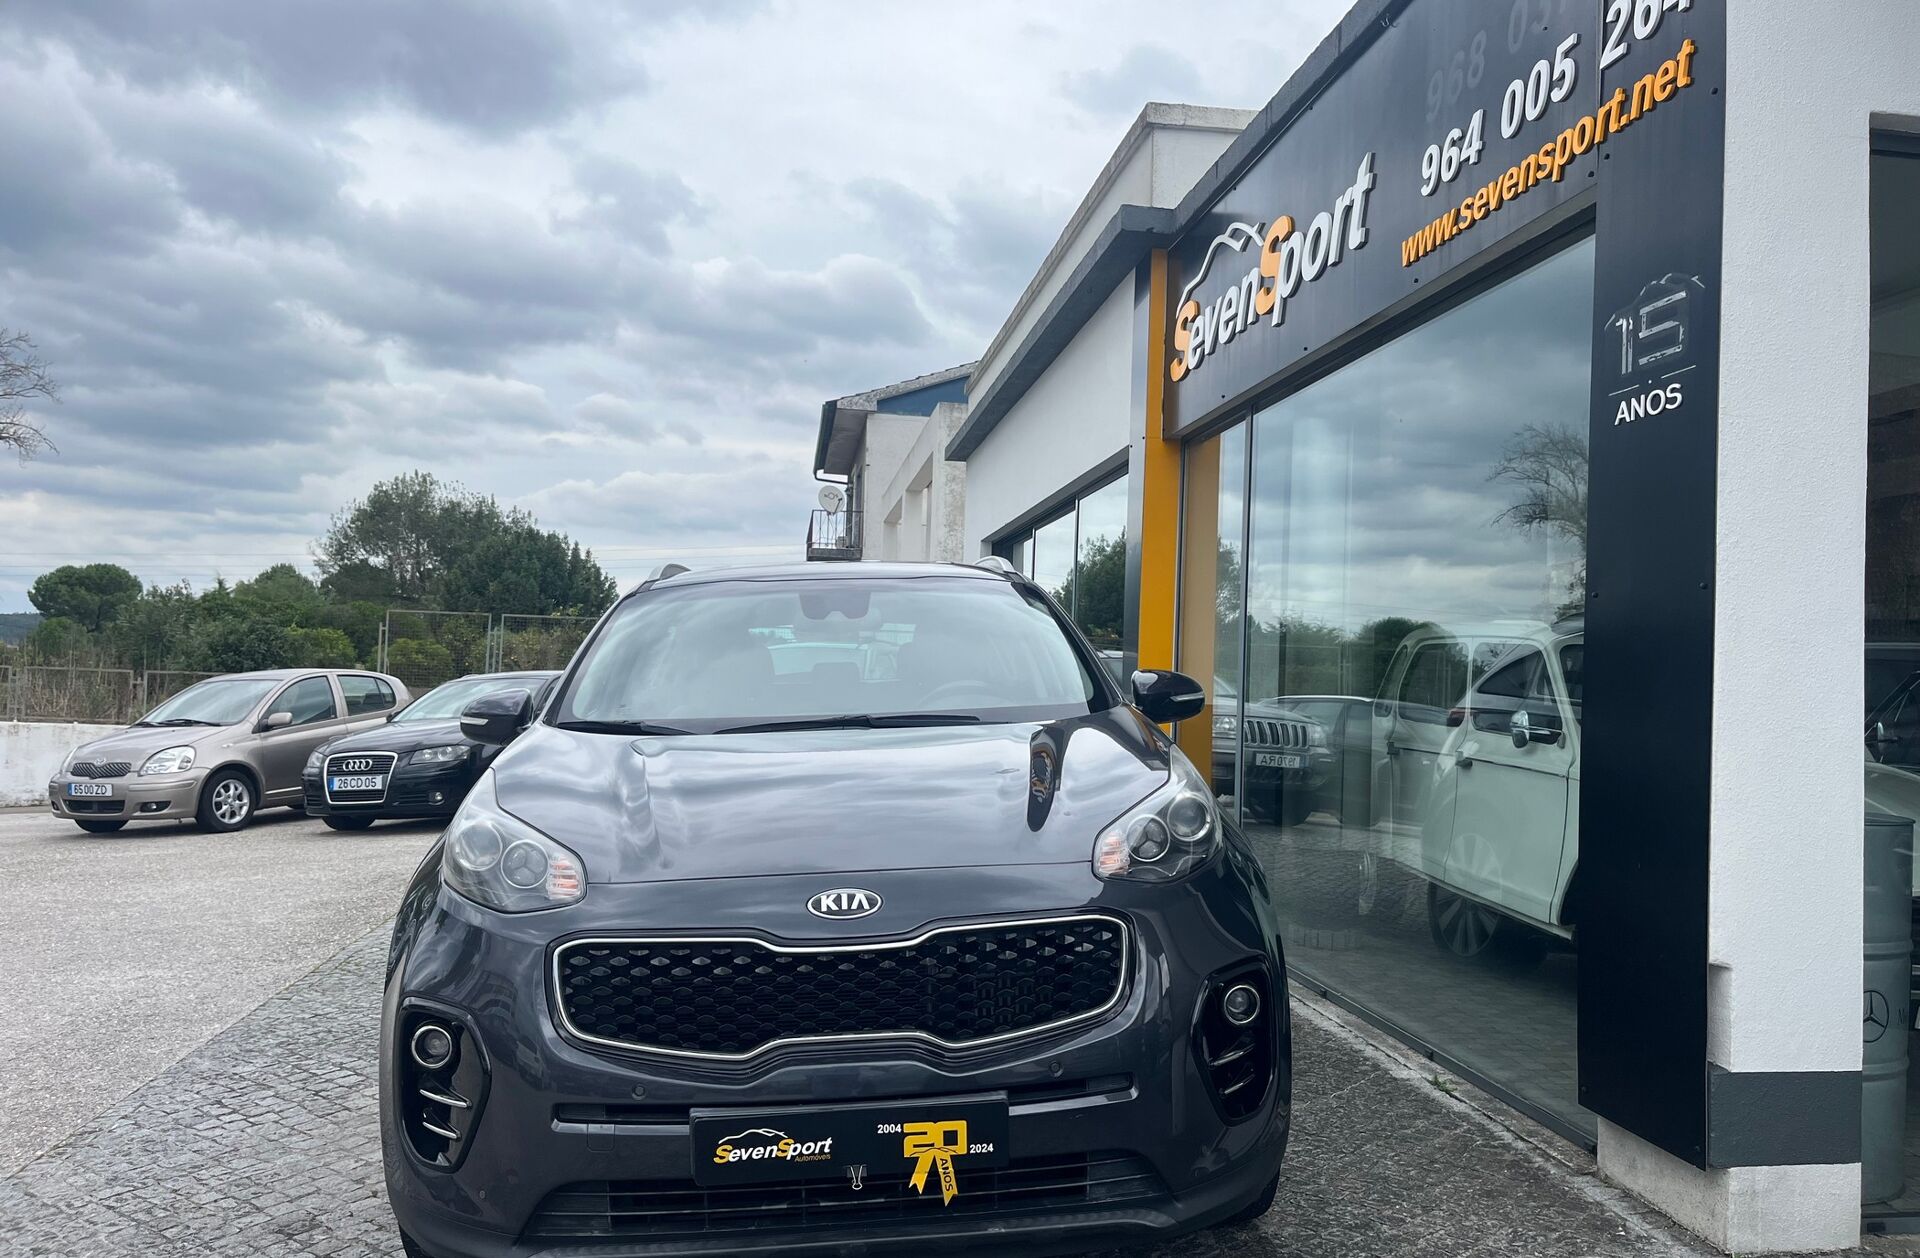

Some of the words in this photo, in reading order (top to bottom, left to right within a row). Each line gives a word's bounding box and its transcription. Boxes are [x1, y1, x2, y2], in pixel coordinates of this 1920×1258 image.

[1421, 109, 1484, 196] 964
[1501, 33, 1579, 139] 005
[1600, 0, 1691, 70] 26
[1402, 39, 1695, 267] www.sevensport.net
[1170, 152, 1377, 382] SevenSport
[1614, 383, 1683, 426] ANOS
[820, 893, 871, 912] KIA
[877, 1123, 902, 1134] 2004
[903, 1120, 967, 1158] 20
[713, 1137, 832, 1164] SevenSport
[969, 1142, 994, 1154] 2024
[939, 1157, 954, 1192] ANOS
